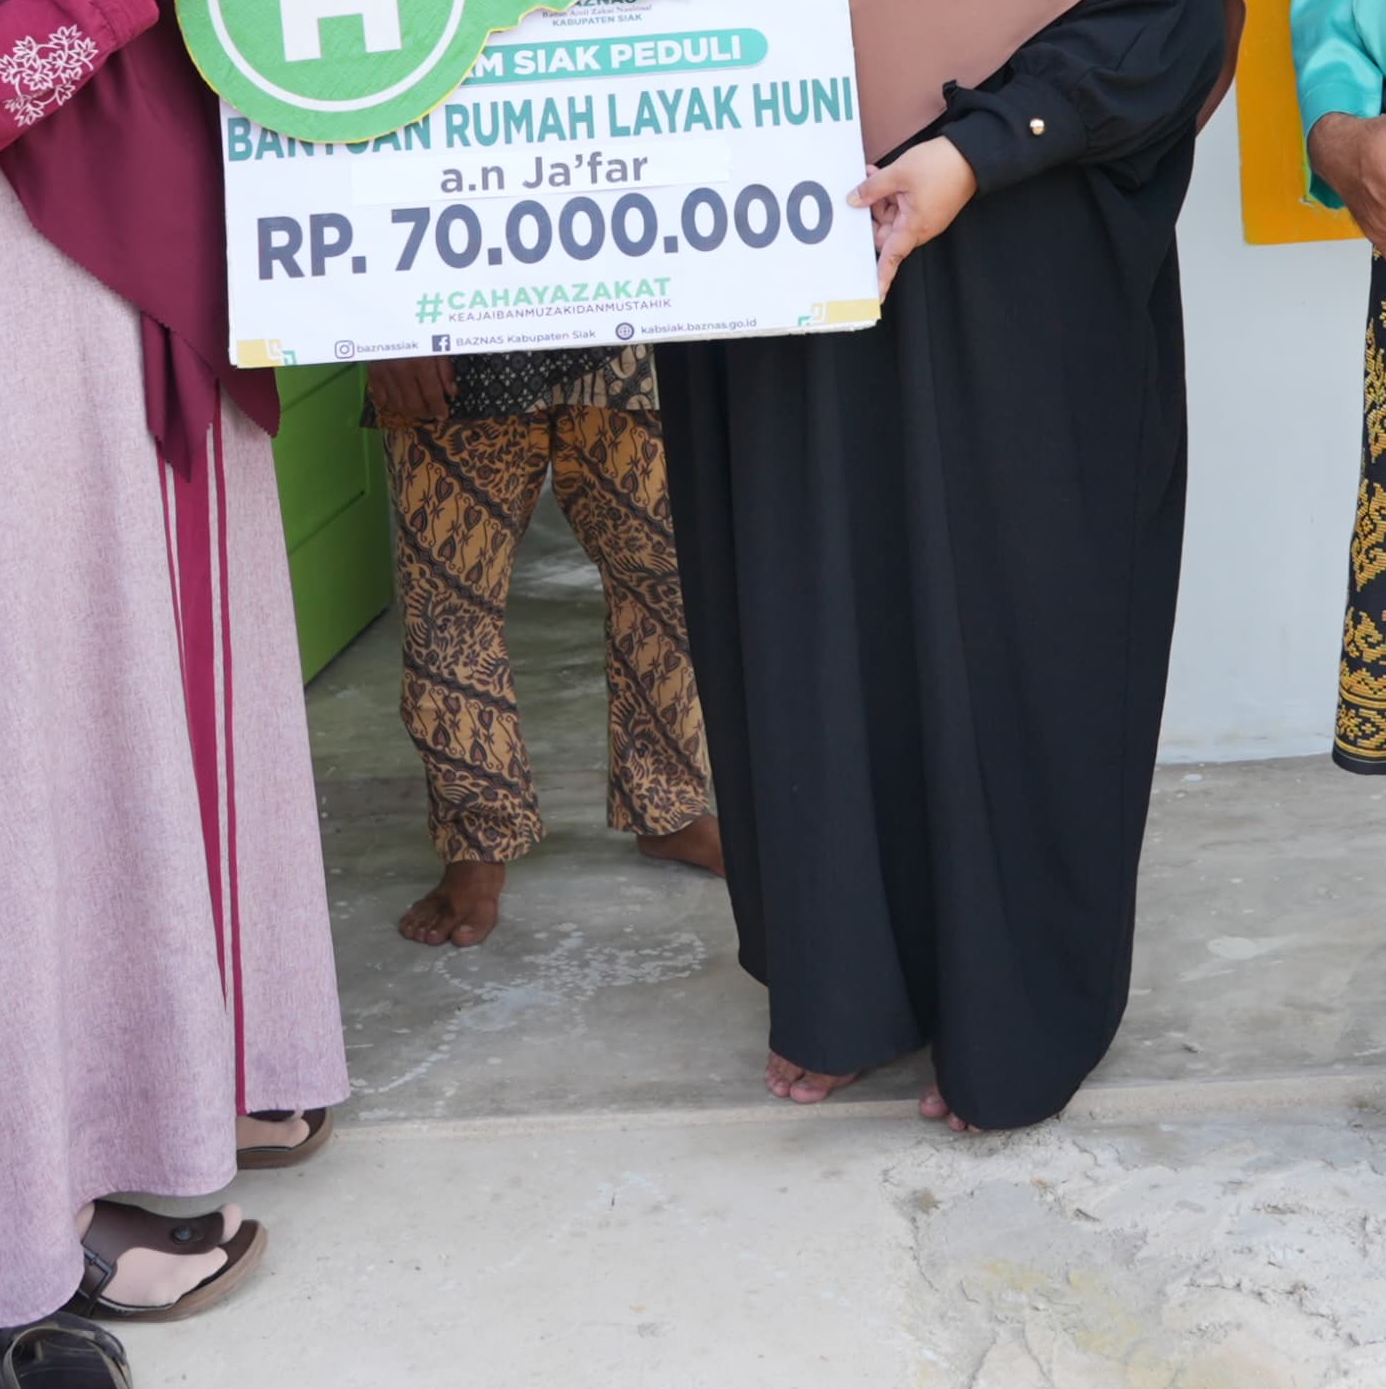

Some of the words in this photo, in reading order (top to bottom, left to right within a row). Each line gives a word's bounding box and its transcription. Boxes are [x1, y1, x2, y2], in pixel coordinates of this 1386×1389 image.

[552, 16, 615, 27] KABUPATEN
[618, 13, 643, 23] SIAK
[514, 43, 601, 75] SIAK
[610, 34, 742, 69] PEDULI
[445, 94, 595, 149] RUMAH
[607, 84, 742, 138] LAYAK
[752, 76, 854, 128] HUNI
[440, 164, 505, 194] a.n
[522, 151, 649, 190] Ja'far
[256, 213, 368, 281] RP.
[391, 180, 834, 273] 70.000.000
[415, 277, 672, 324] #CAHAYAZAKAT
[448, 298, 673, 323] KEAJAIBANMUZAKIDANMUSTAHIK
[455, 335, 504, 347] BAZNAS
[507, 331, 569, 346] Kabupaten
[572, 329, 597, 340] Siak
[640, 318, 757, 335] kabsiak.baznas.go.id
[356, 340, 419, 353] baznassiak
